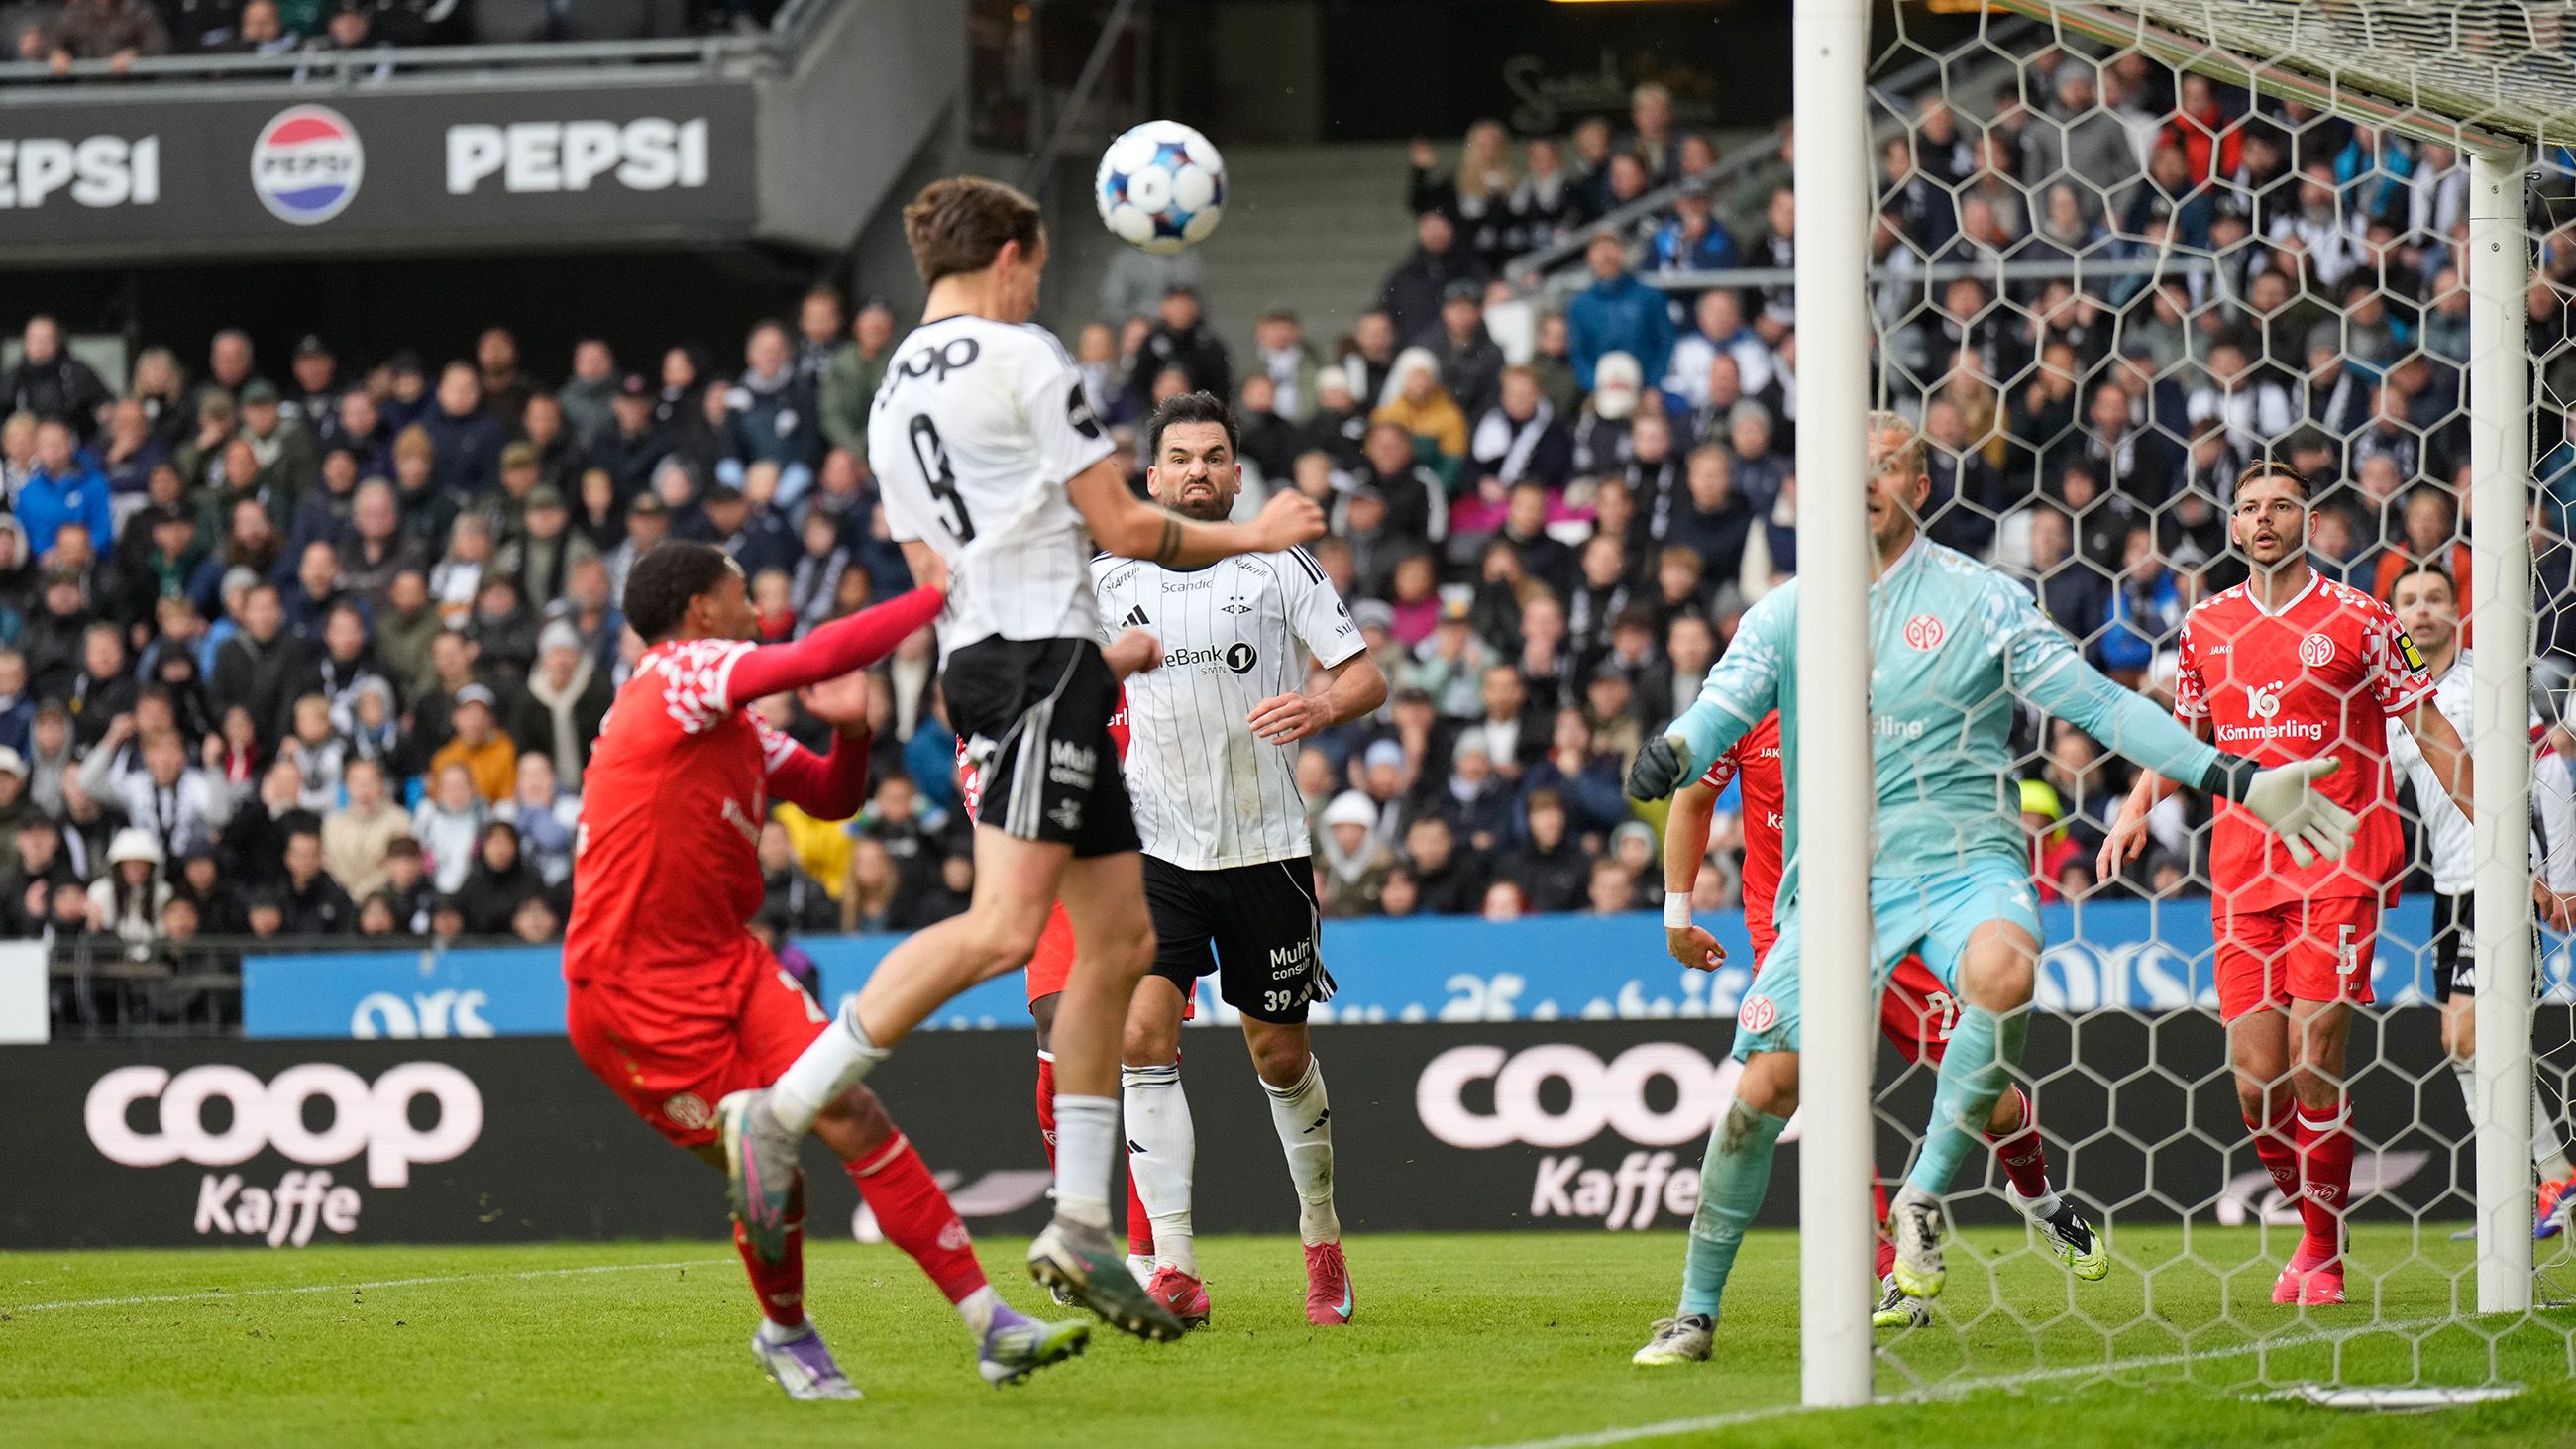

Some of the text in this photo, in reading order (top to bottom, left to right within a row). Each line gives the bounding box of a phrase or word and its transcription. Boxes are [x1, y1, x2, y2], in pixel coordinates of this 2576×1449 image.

[446, 116, 709, 195] PEPSI
[911, 413, 976, 544] 9
[1161, 579, 1214, 594] Scandic
[1158, 644, 1224, 669] reBank
[2209, 644, 2233, 656] JAKO
[1200, 666, 1227, 676] SMN
[1871, 715, 1924, 741] rling
[2216, 719, 2322, 742] Kömmerling
[1760, 747, 1781, 758] JAK
[1269, 937, 1311, 968] Multi
[2336, 924, 2358, 975] 5
[1264, 989, 1292, 1012] 39
[84, 1060, 483, 1188] coop
[1530, 1152, 1701, 1231] Kaffe
[195, 1171, 362, 1247] Kaffe
